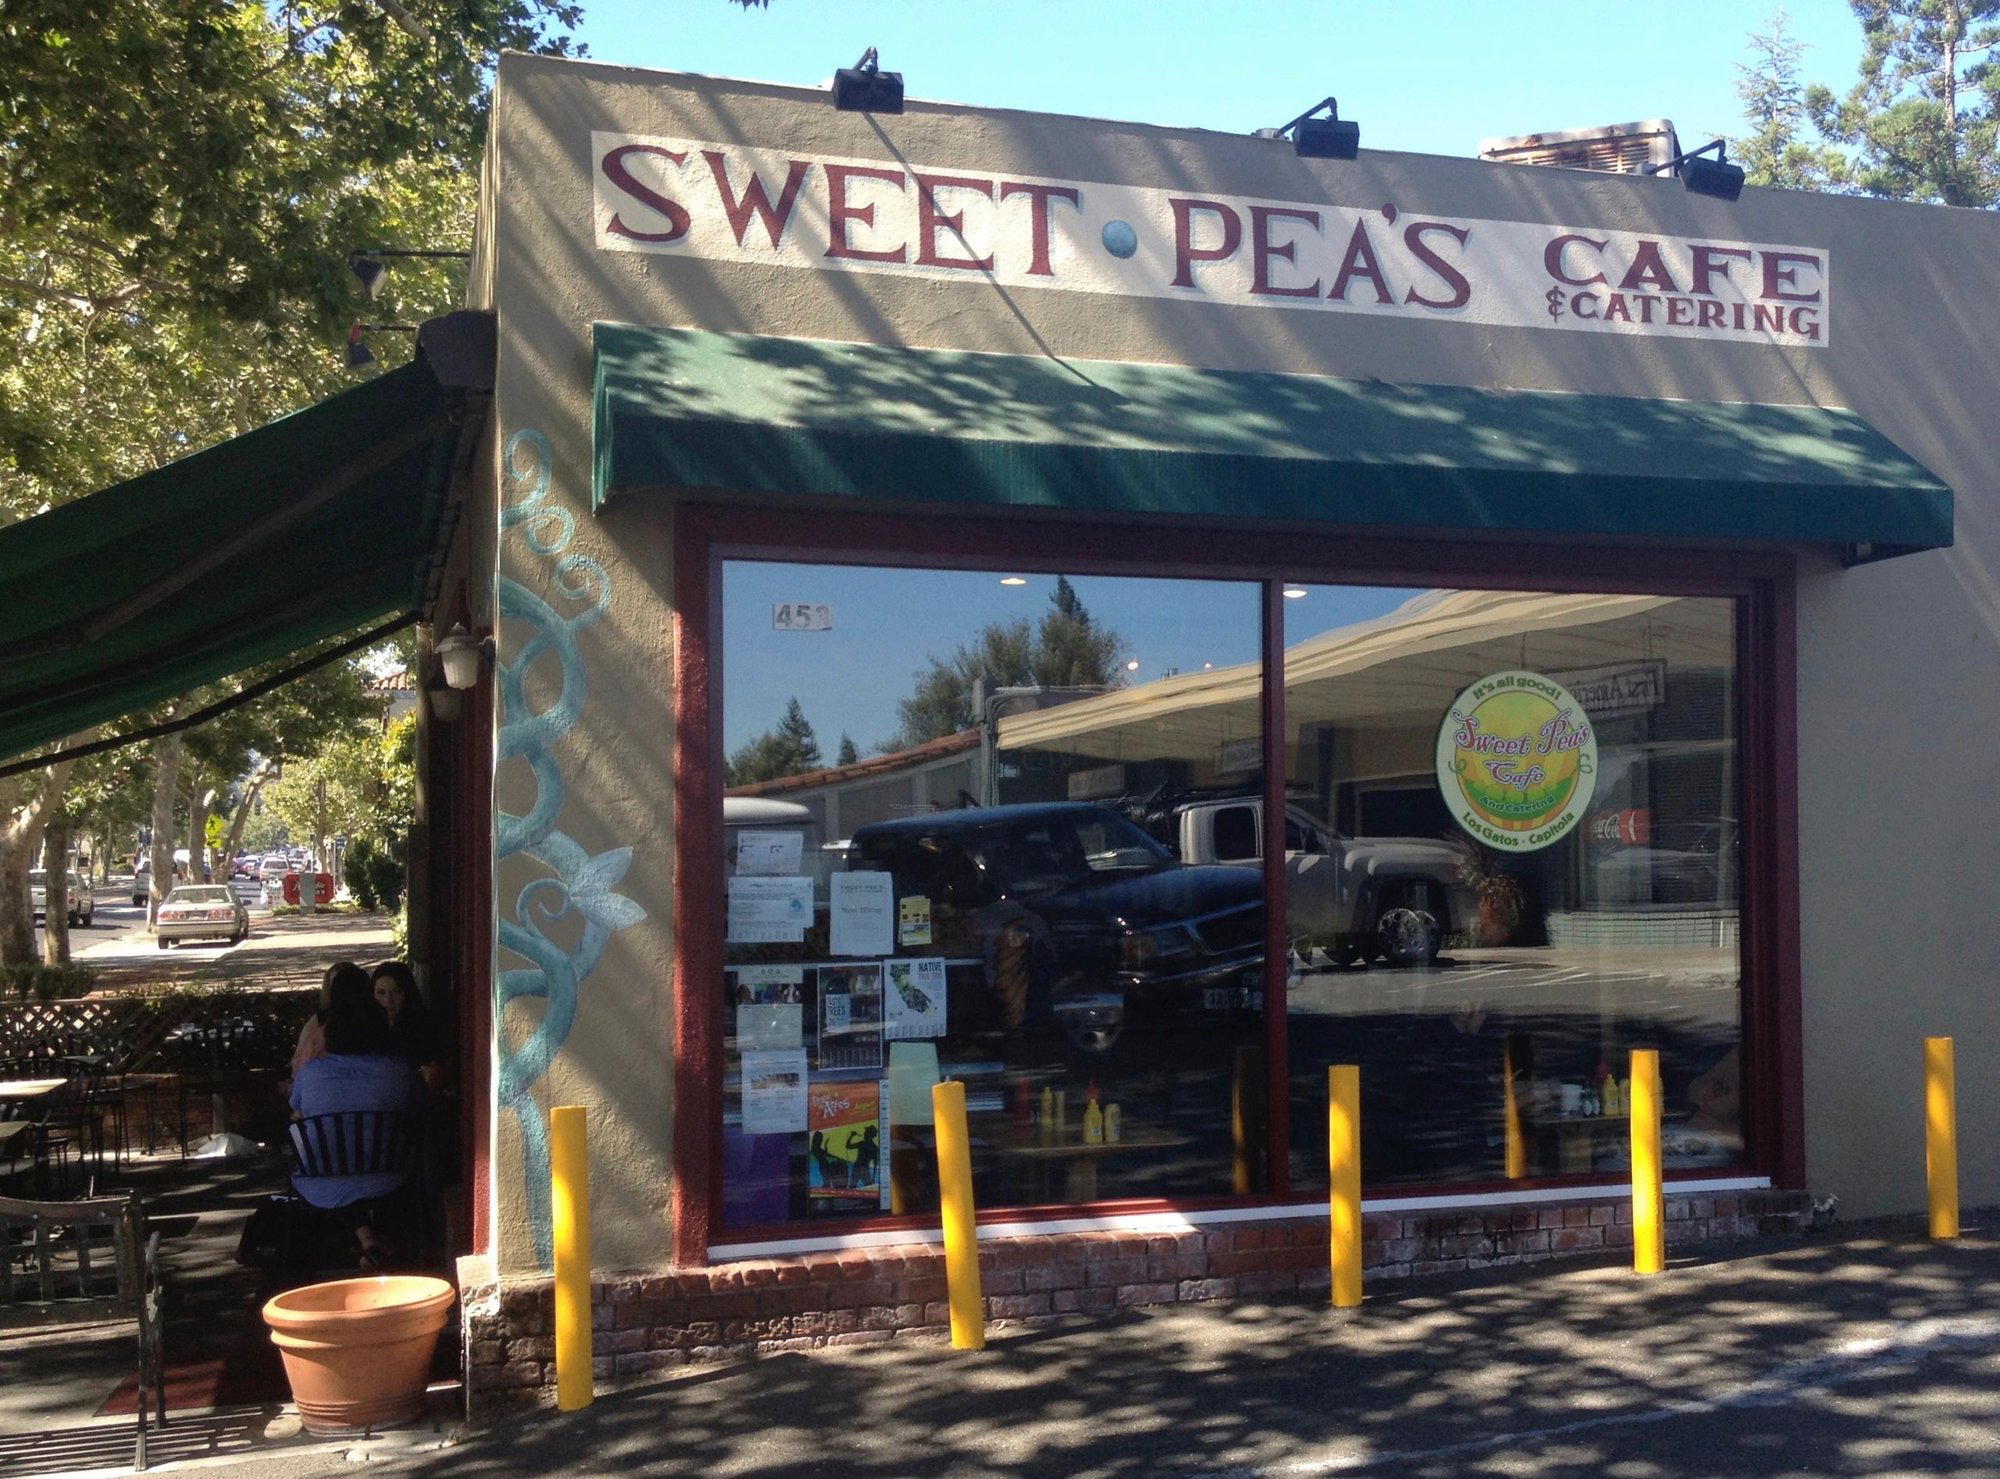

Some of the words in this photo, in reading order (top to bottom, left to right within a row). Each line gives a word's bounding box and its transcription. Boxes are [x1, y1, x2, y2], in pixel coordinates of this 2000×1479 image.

[601, 143, 1079, 277] SWEET
[1168, 197, 1471, 309] PEA'S
[1544, 233, 1822, 302] CAFE
[776, 603, 831, 628] 453
[1496, 676, 1514, 688] all
[1516, 677, 1562, 700] good!
[1451, 709, 1531, 755] Sweet
[1463, 812, 1482, 833] Los
[1482, 827, 1519, 846] Gatos
[1529, 812, 1574, 844] Capitola
[918, 961, 942, 973] NATIVE
